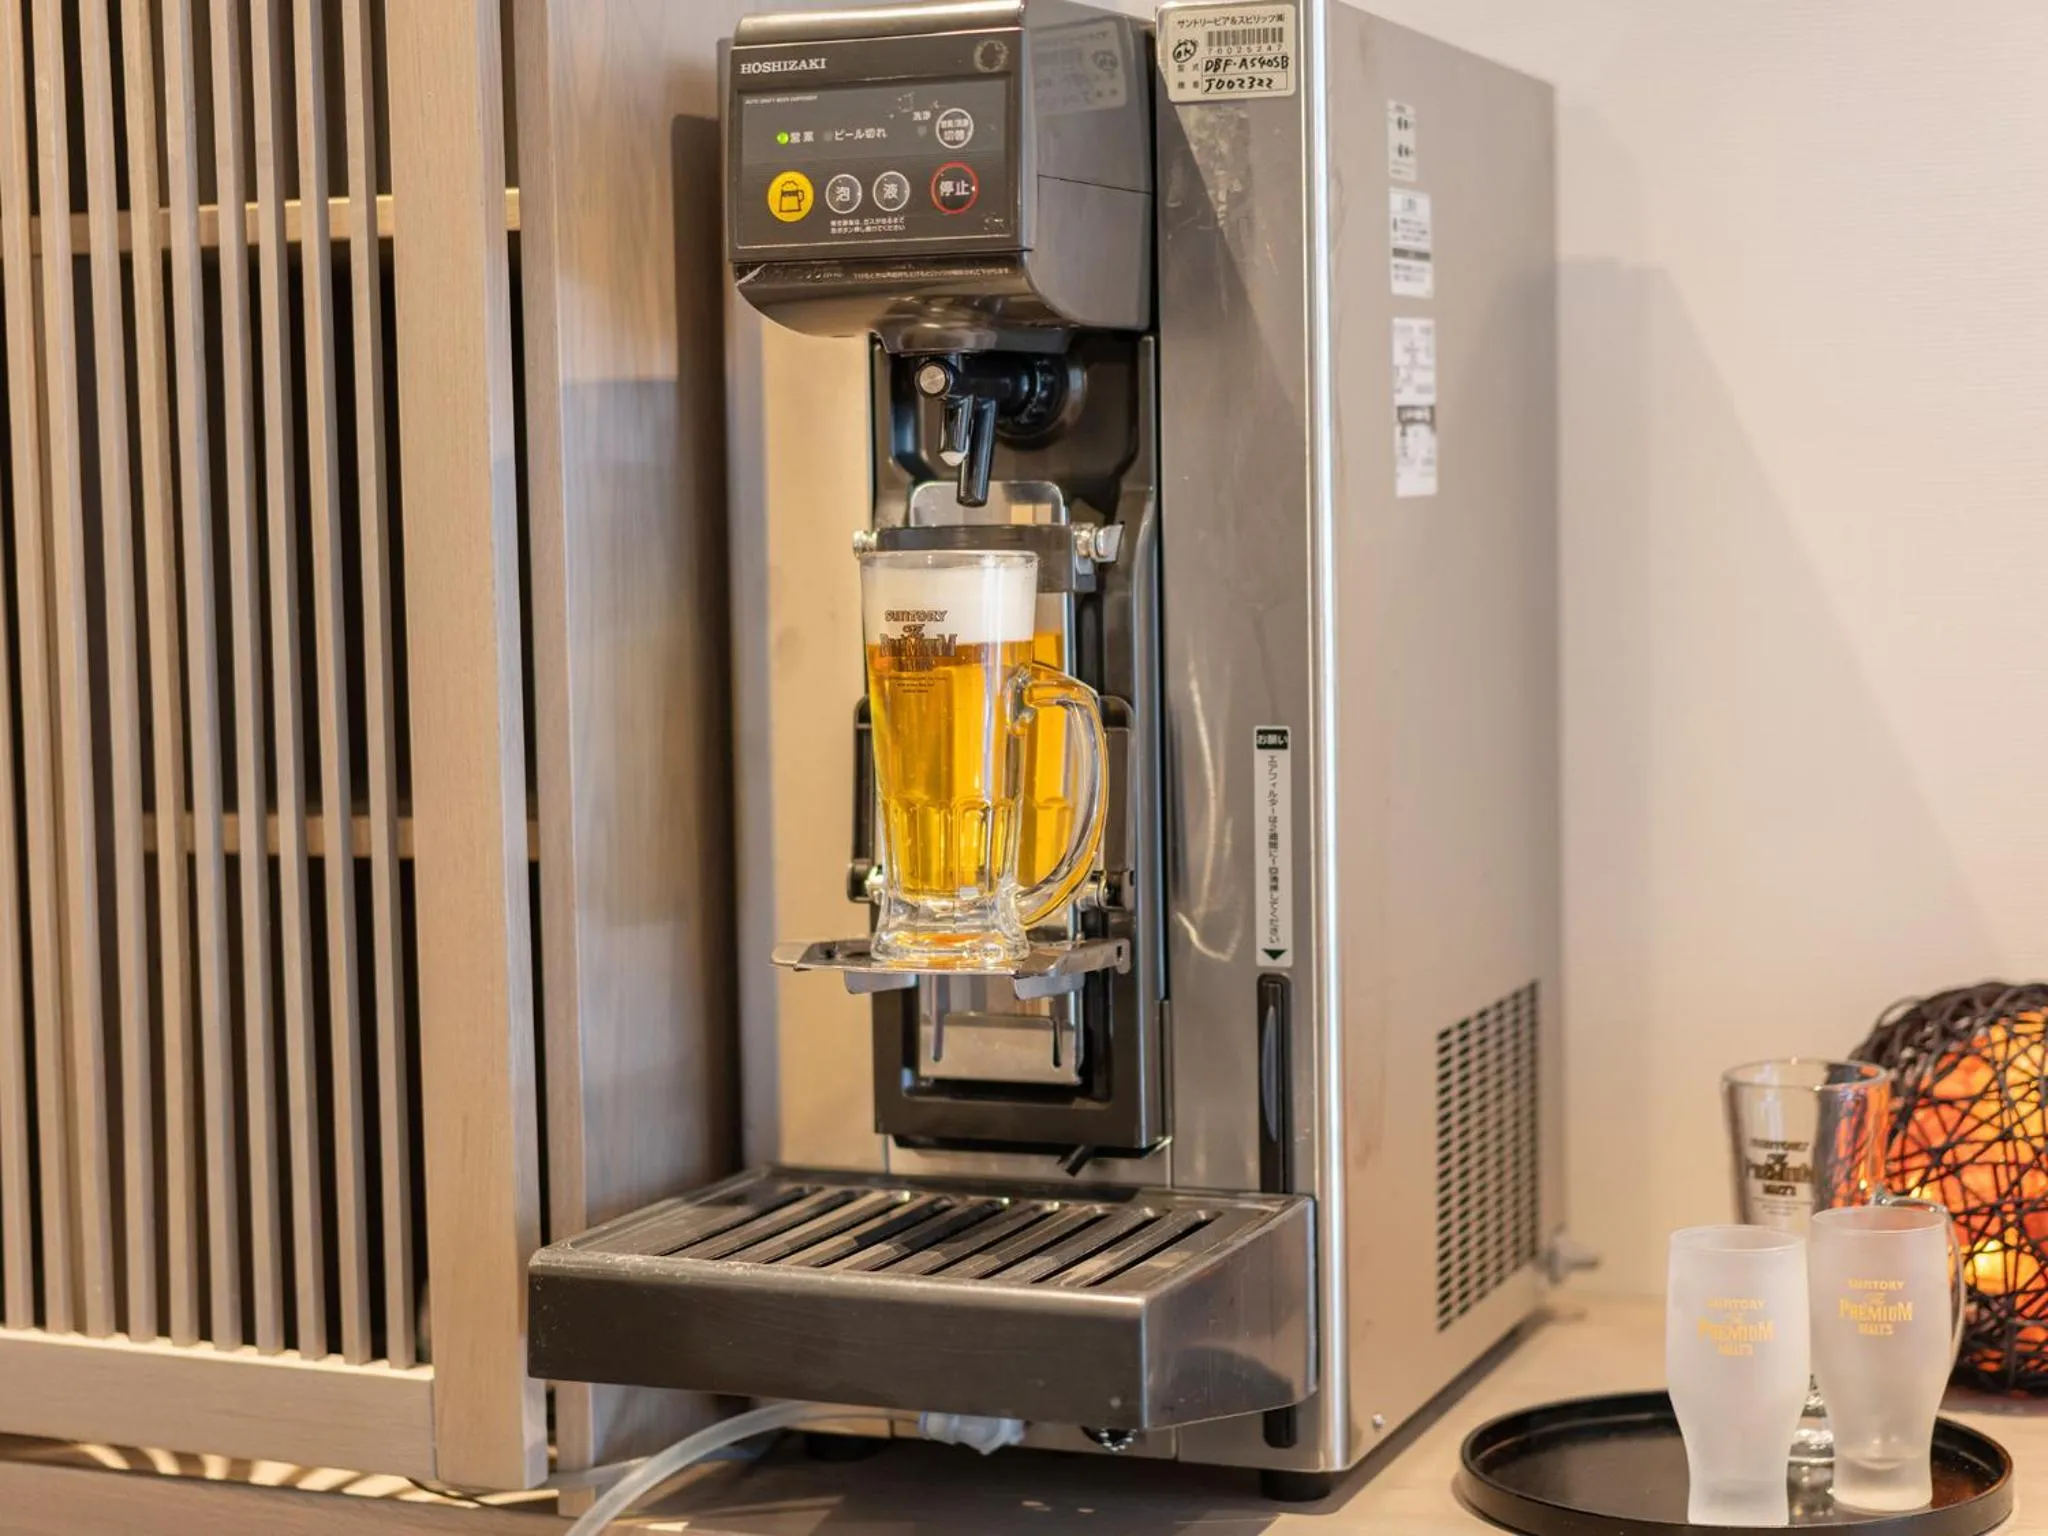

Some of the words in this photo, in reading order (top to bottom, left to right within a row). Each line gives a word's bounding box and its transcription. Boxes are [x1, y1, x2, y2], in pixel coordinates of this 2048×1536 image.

[740, 58, 827, 74] HOSHIZAKI
[834, 127, 887, 141] ビール切れ
[836, 186, 851, 202] 泡
[883, 183, 898, 200] 液
[939, 180, 970, 197] 停止
[884, 609, 948, 622] SUNTORY
[1748, 1138, 1809, 1153] SUNTORY
[1848, 1278, 1905, 1290] SUNTORY
[1706, 1297, 1767, 1310] SUNTORY
[1838, 1297, 1913, 1322] PREMIUM
[1697, 1316, 1775, 1342] PREMIUM
